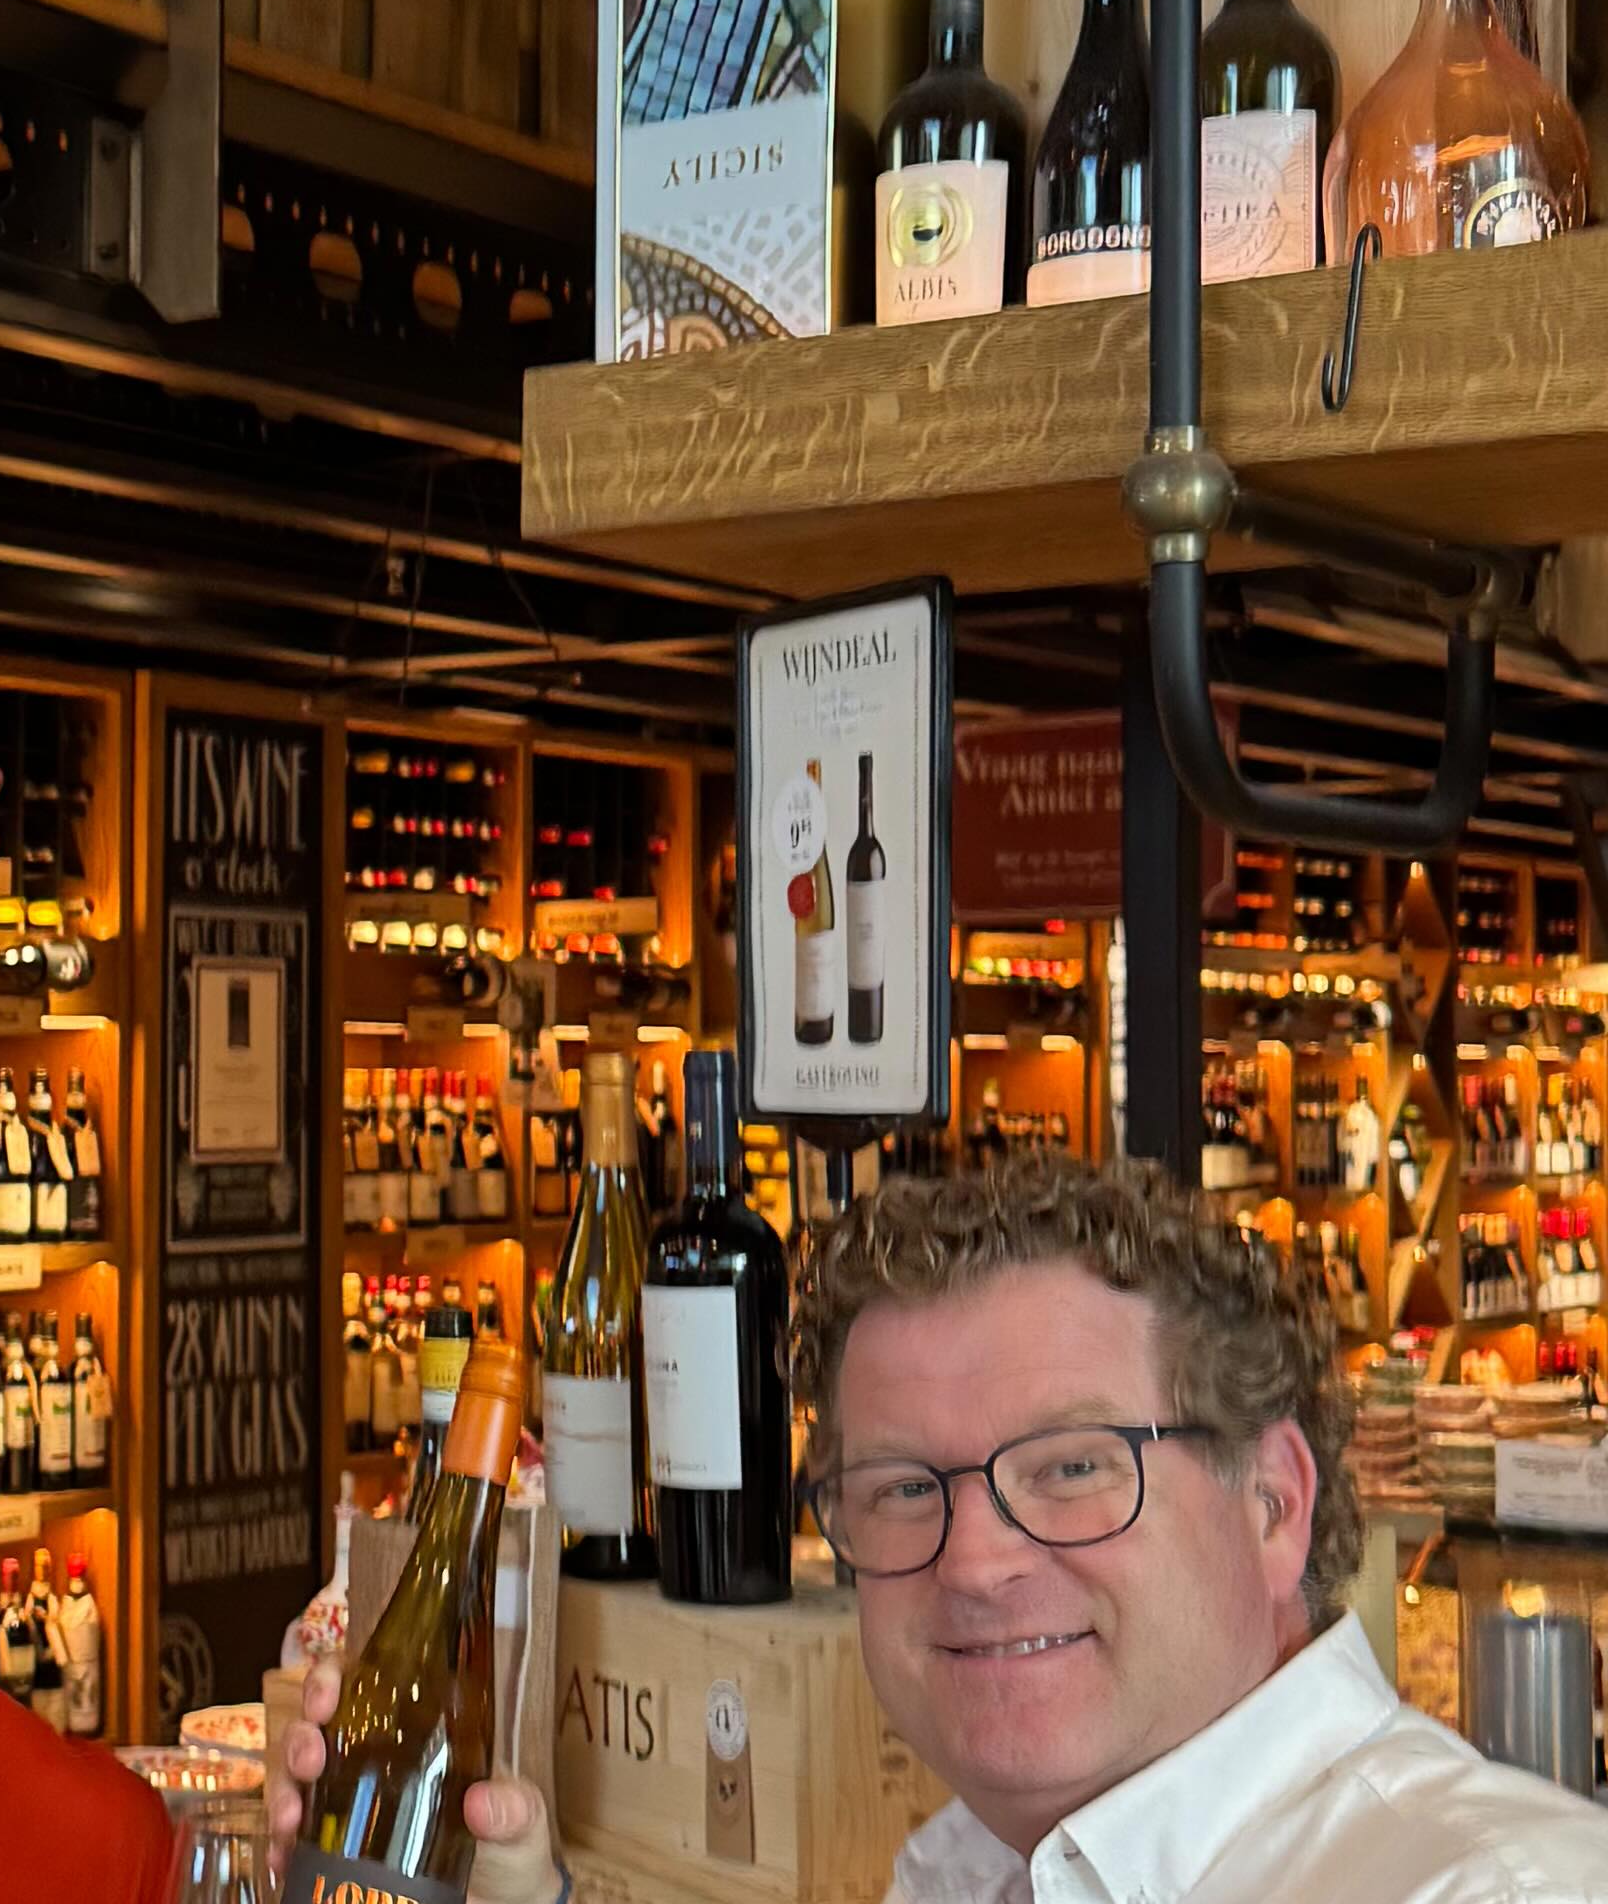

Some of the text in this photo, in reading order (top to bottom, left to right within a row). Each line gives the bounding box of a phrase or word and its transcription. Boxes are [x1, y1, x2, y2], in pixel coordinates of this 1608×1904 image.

[662, 137, 783, 190] SICILY
[782, 629, 898, 687] WIJNDEAL
[229, 737, 309, 852] WINE
[954, 746, 1049, 785] Vraag
[559, 1666, 655, 1763] ATIS
